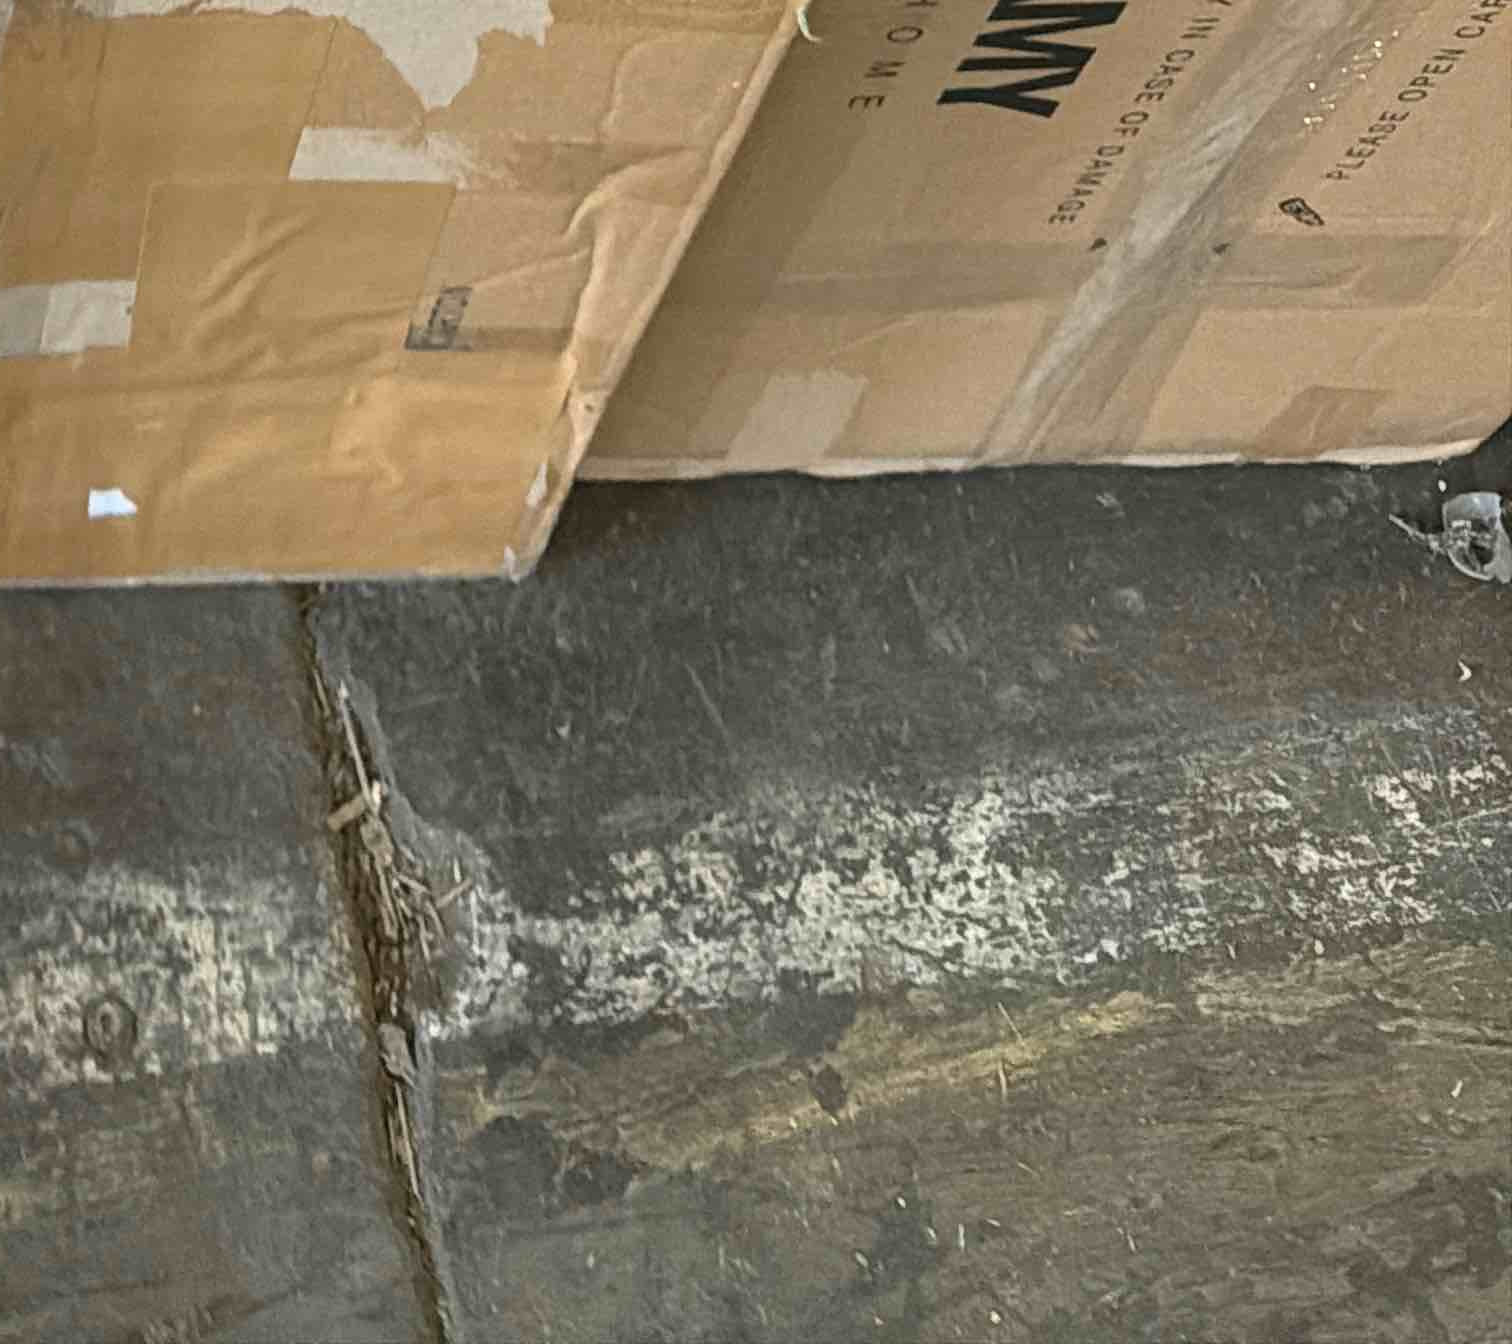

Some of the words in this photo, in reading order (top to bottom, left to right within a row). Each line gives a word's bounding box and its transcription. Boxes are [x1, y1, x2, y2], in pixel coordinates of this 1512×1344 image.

[1180, 15, 1221, 40] IN
[1134, 48, 1195, 104] CASE
[1112, 111, 1151, 138] OF
[1324, 110, 1410, 182] PLEASE
[1398, 47, 1466, 105] OPEN
[1048, 143, 1125, 226] DAMAGE
